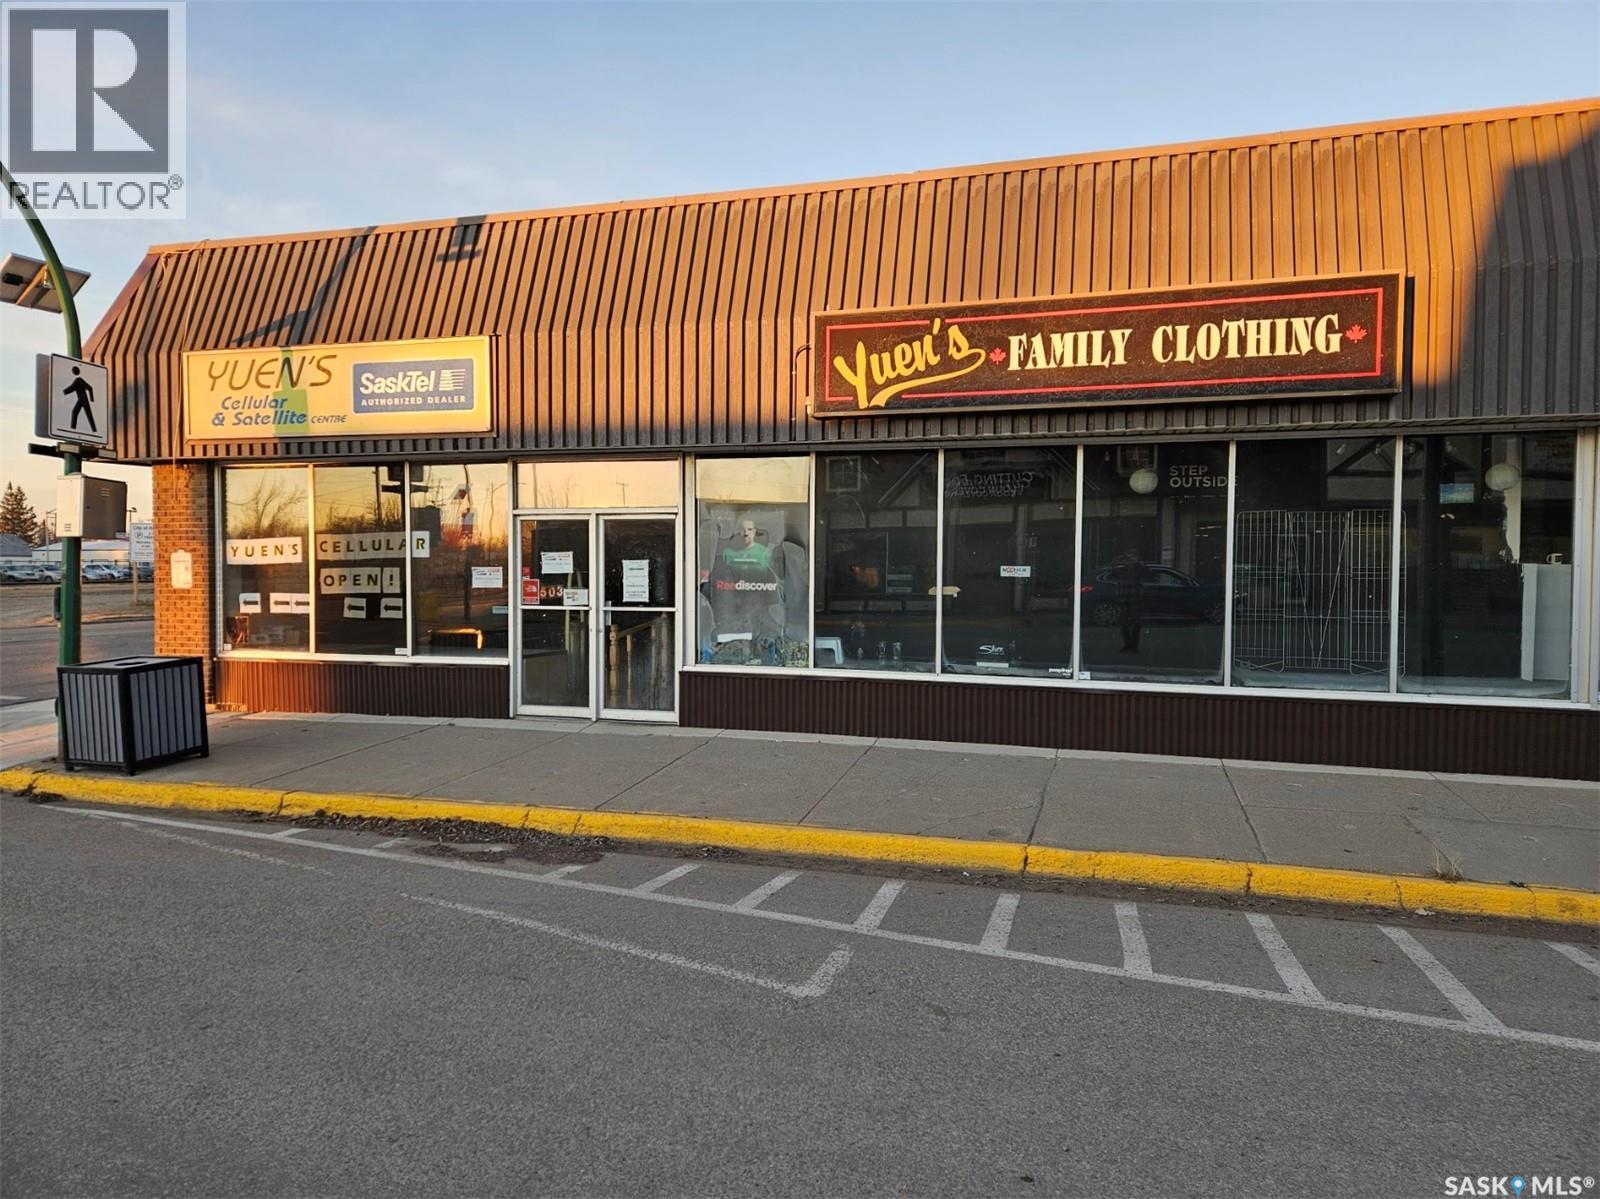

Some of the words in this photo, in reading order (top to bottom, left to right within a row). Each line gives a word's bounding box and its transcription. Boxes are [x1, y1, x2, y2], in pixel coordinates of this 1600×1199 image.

[833, 317, 986, 409] Yuen's
[1006, 328, 1134, 371] FAMILY
[1151, 313, 1343, 365] CLOTHING
[207, 354, 338, 392] YUEN'S
[359, 368, 436, 394] SaskTel
[221, 394, 288, 410] Cellular
[361, 396, 423, 407] AUTHORIZED
[427, 394, 466, 405] DEALER
[211, 412, 225, 427] &
[232, 409, 308, 426] Satellite
[310, 414, 348, 424] CENTRE
[1169, 465, 1209, 476] STEP
[230, 543, 299, 558] YUEN'S
[540, 586, 563, 598] 503
